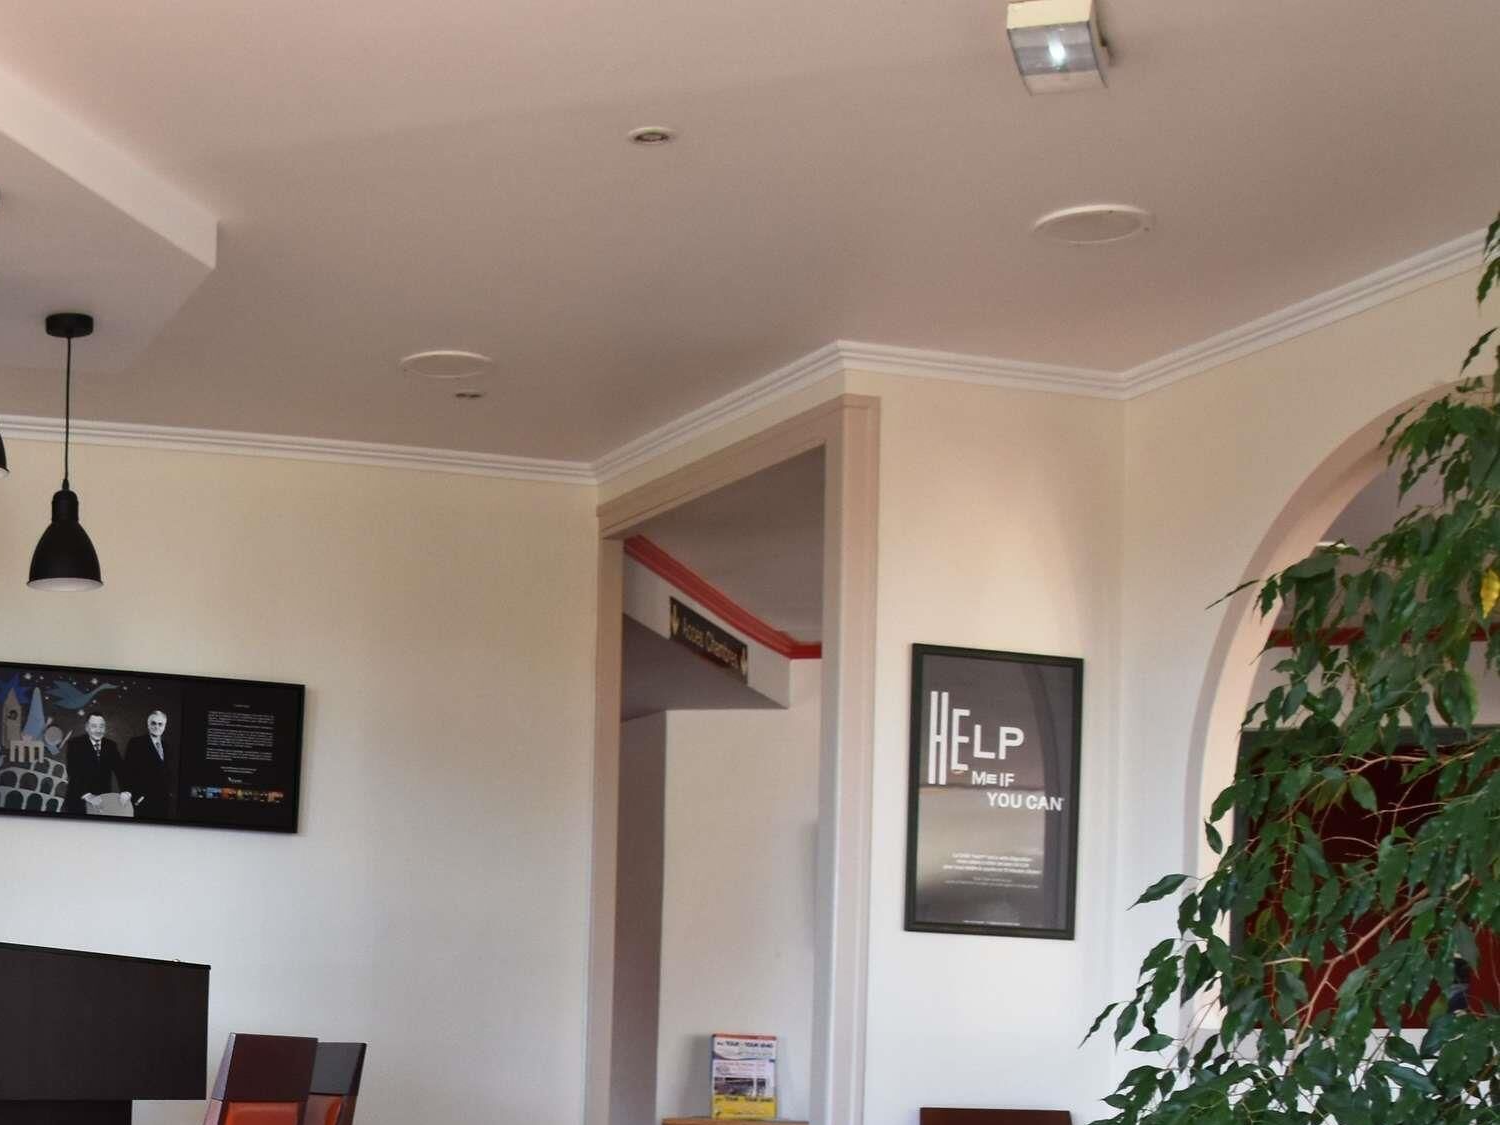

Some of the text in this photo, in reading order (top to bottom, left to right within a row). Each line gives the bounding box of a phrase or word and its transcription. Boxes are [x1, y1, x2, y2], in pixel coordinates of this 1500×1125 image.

[927, 690, 1025, 786] HELP
[999, 772, 1015, 788] IF
[986, 791, 1063, 812] YOU CAN
